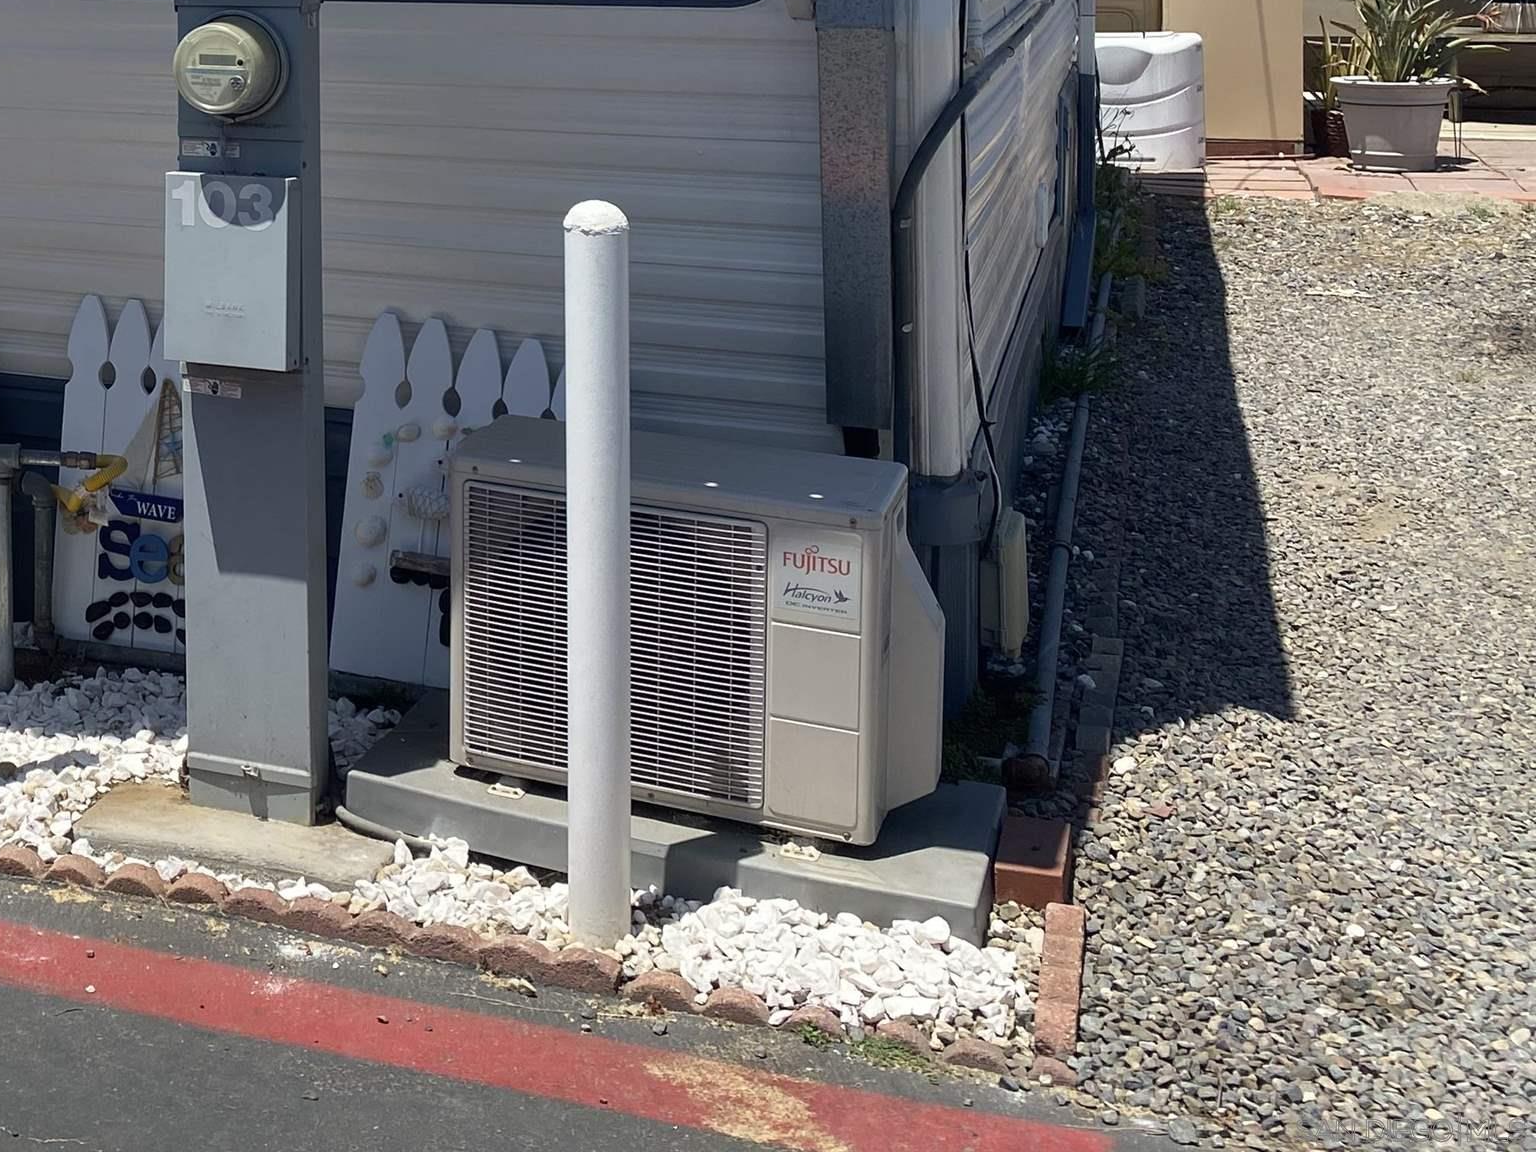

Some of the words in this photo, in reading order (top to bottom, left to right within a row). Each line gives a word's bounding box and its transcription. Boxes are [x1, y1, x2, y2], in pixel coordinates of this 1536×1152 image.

[171, 180, 274, 231] 103
[136, 500, 177, 520] WAVE
[782, 545, 851, 576] FUJITSU
[783, 581, 832, 603] Halcyon
